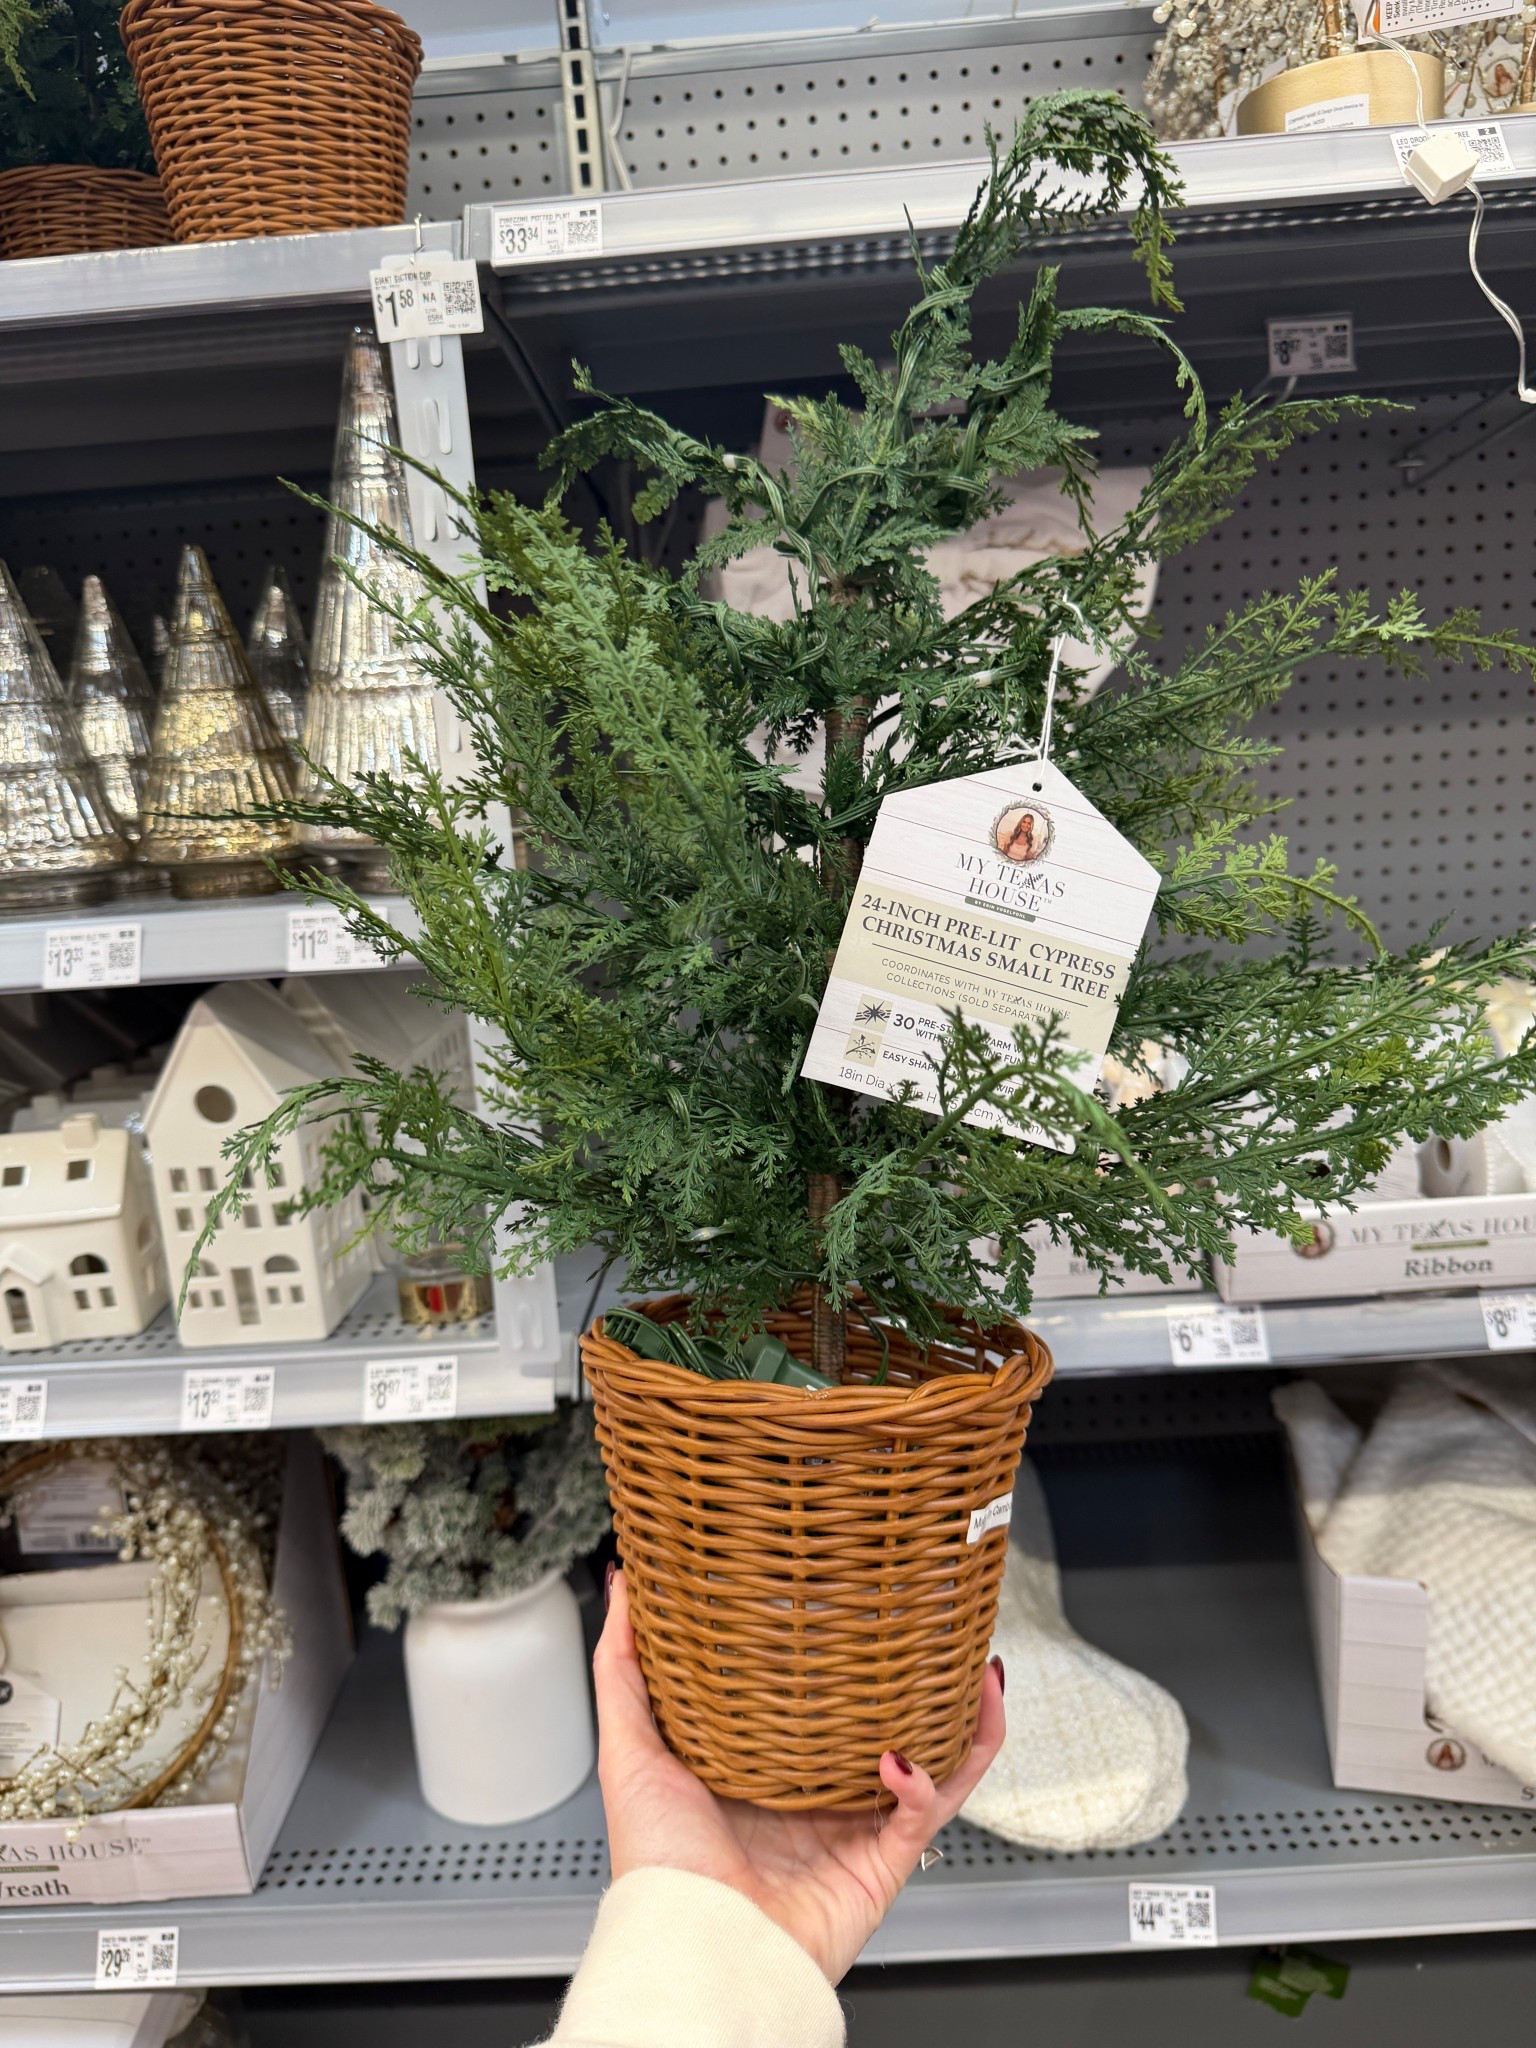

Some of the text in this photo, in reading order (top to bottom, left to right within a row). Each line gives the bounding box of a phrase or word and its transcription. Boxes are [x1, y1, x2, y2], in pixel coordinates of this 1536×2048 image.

[374, 276, 392, 287] GIANT
[419, 271, 432, 281] CUP
[422, 292, 437, 303] NA
[955, 853, 1066, 898] MY TEXAS
[861, 894, 1116, 980] 24-INCH PRE-LIT CYPRESS
[862, 915, 1110, 1000] CHRISTMAS SMALL TREE
[881, 958, 951, 985] COORDINATES
[954, 978, 980, 994] WITH
[983, 987, 999, 999] MY
[1001, 992, 1033, 1009] TEXAS
[886, 972, 956, 999] COLLECTIONS
[958, 992, 989, 1009] (SOLD
[893, 1013, 916, 1030] 30
[882, 1050, 908, 1064] EASY
[839, 1066, 863, 1083] 18in
[865, 1074, 886, 1090] Dia
[926, 1091, 937, 1105] H
[1352, 1225, 1382, 1244] MY
[1404, 1257, 1494, 1278] Ribbon
[0, 1878, 70, 1898] reath
